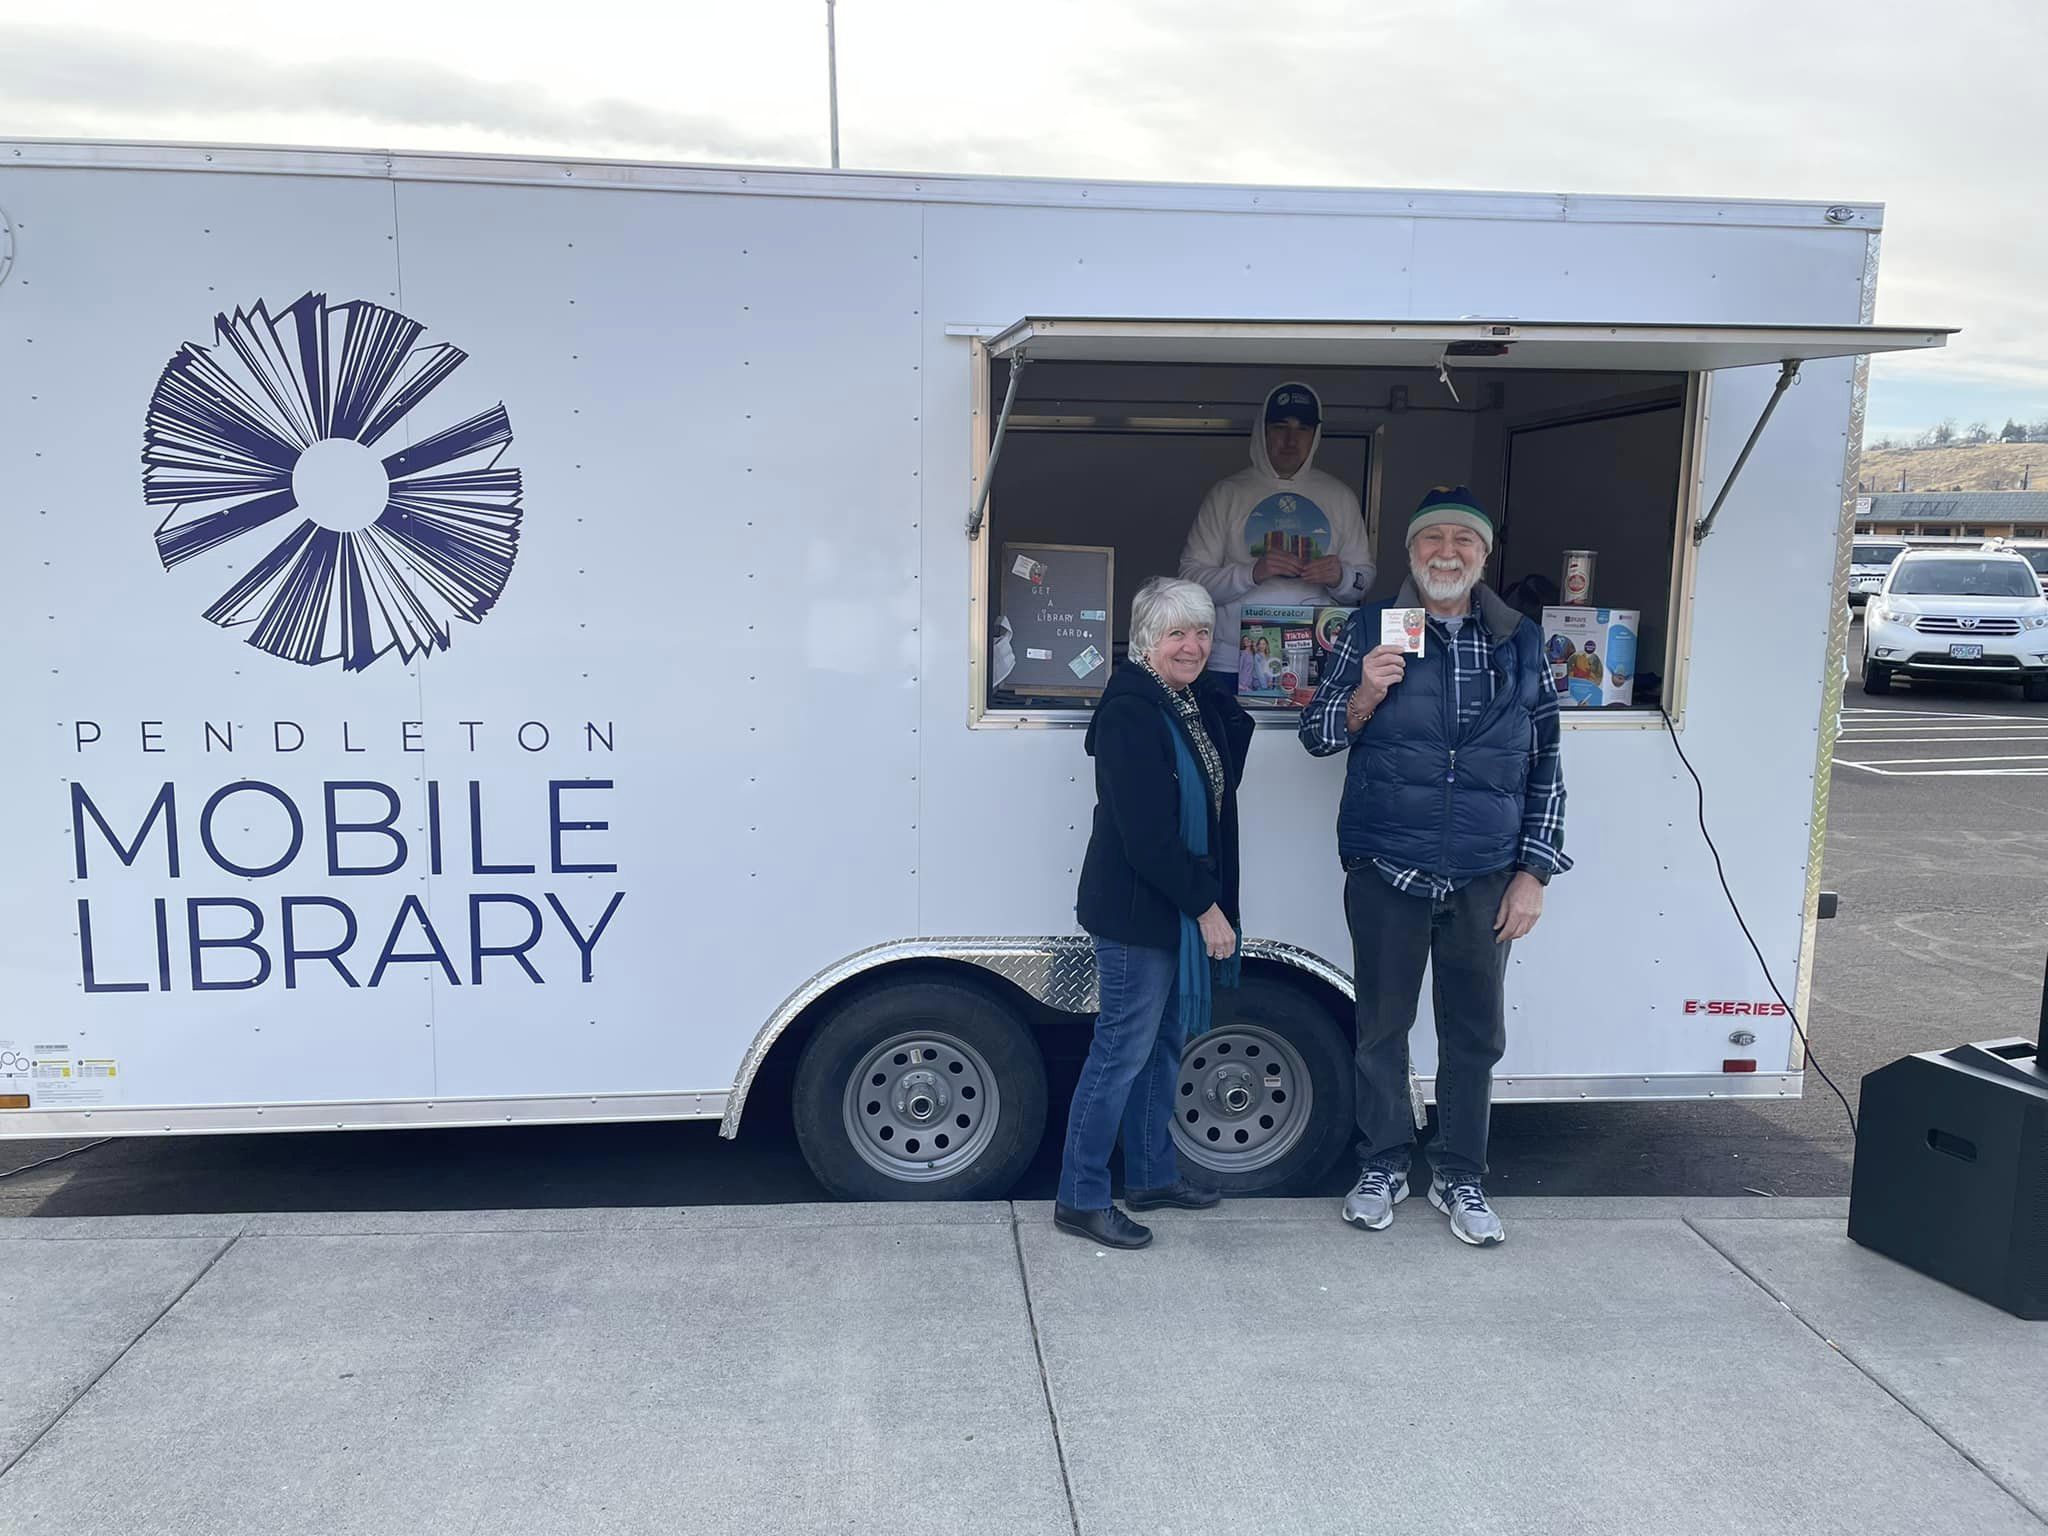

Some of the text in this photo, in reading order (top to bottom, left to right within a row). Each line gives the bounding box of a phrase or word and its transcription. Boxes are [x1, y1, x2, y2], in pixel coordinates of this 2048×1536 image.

[1032, 586, 1050, 595] GET
[1047, 599, 1054, 607] A
[1037, 613, 1074, 622] LIBRARY
[75, 720, 615, 753] PENDLETON
[70, 779, 618, 880] MOBILE
[77, 891, 627, 993] LIBRARY
[1684, 1000, 1786, 1016] E-SERIES
